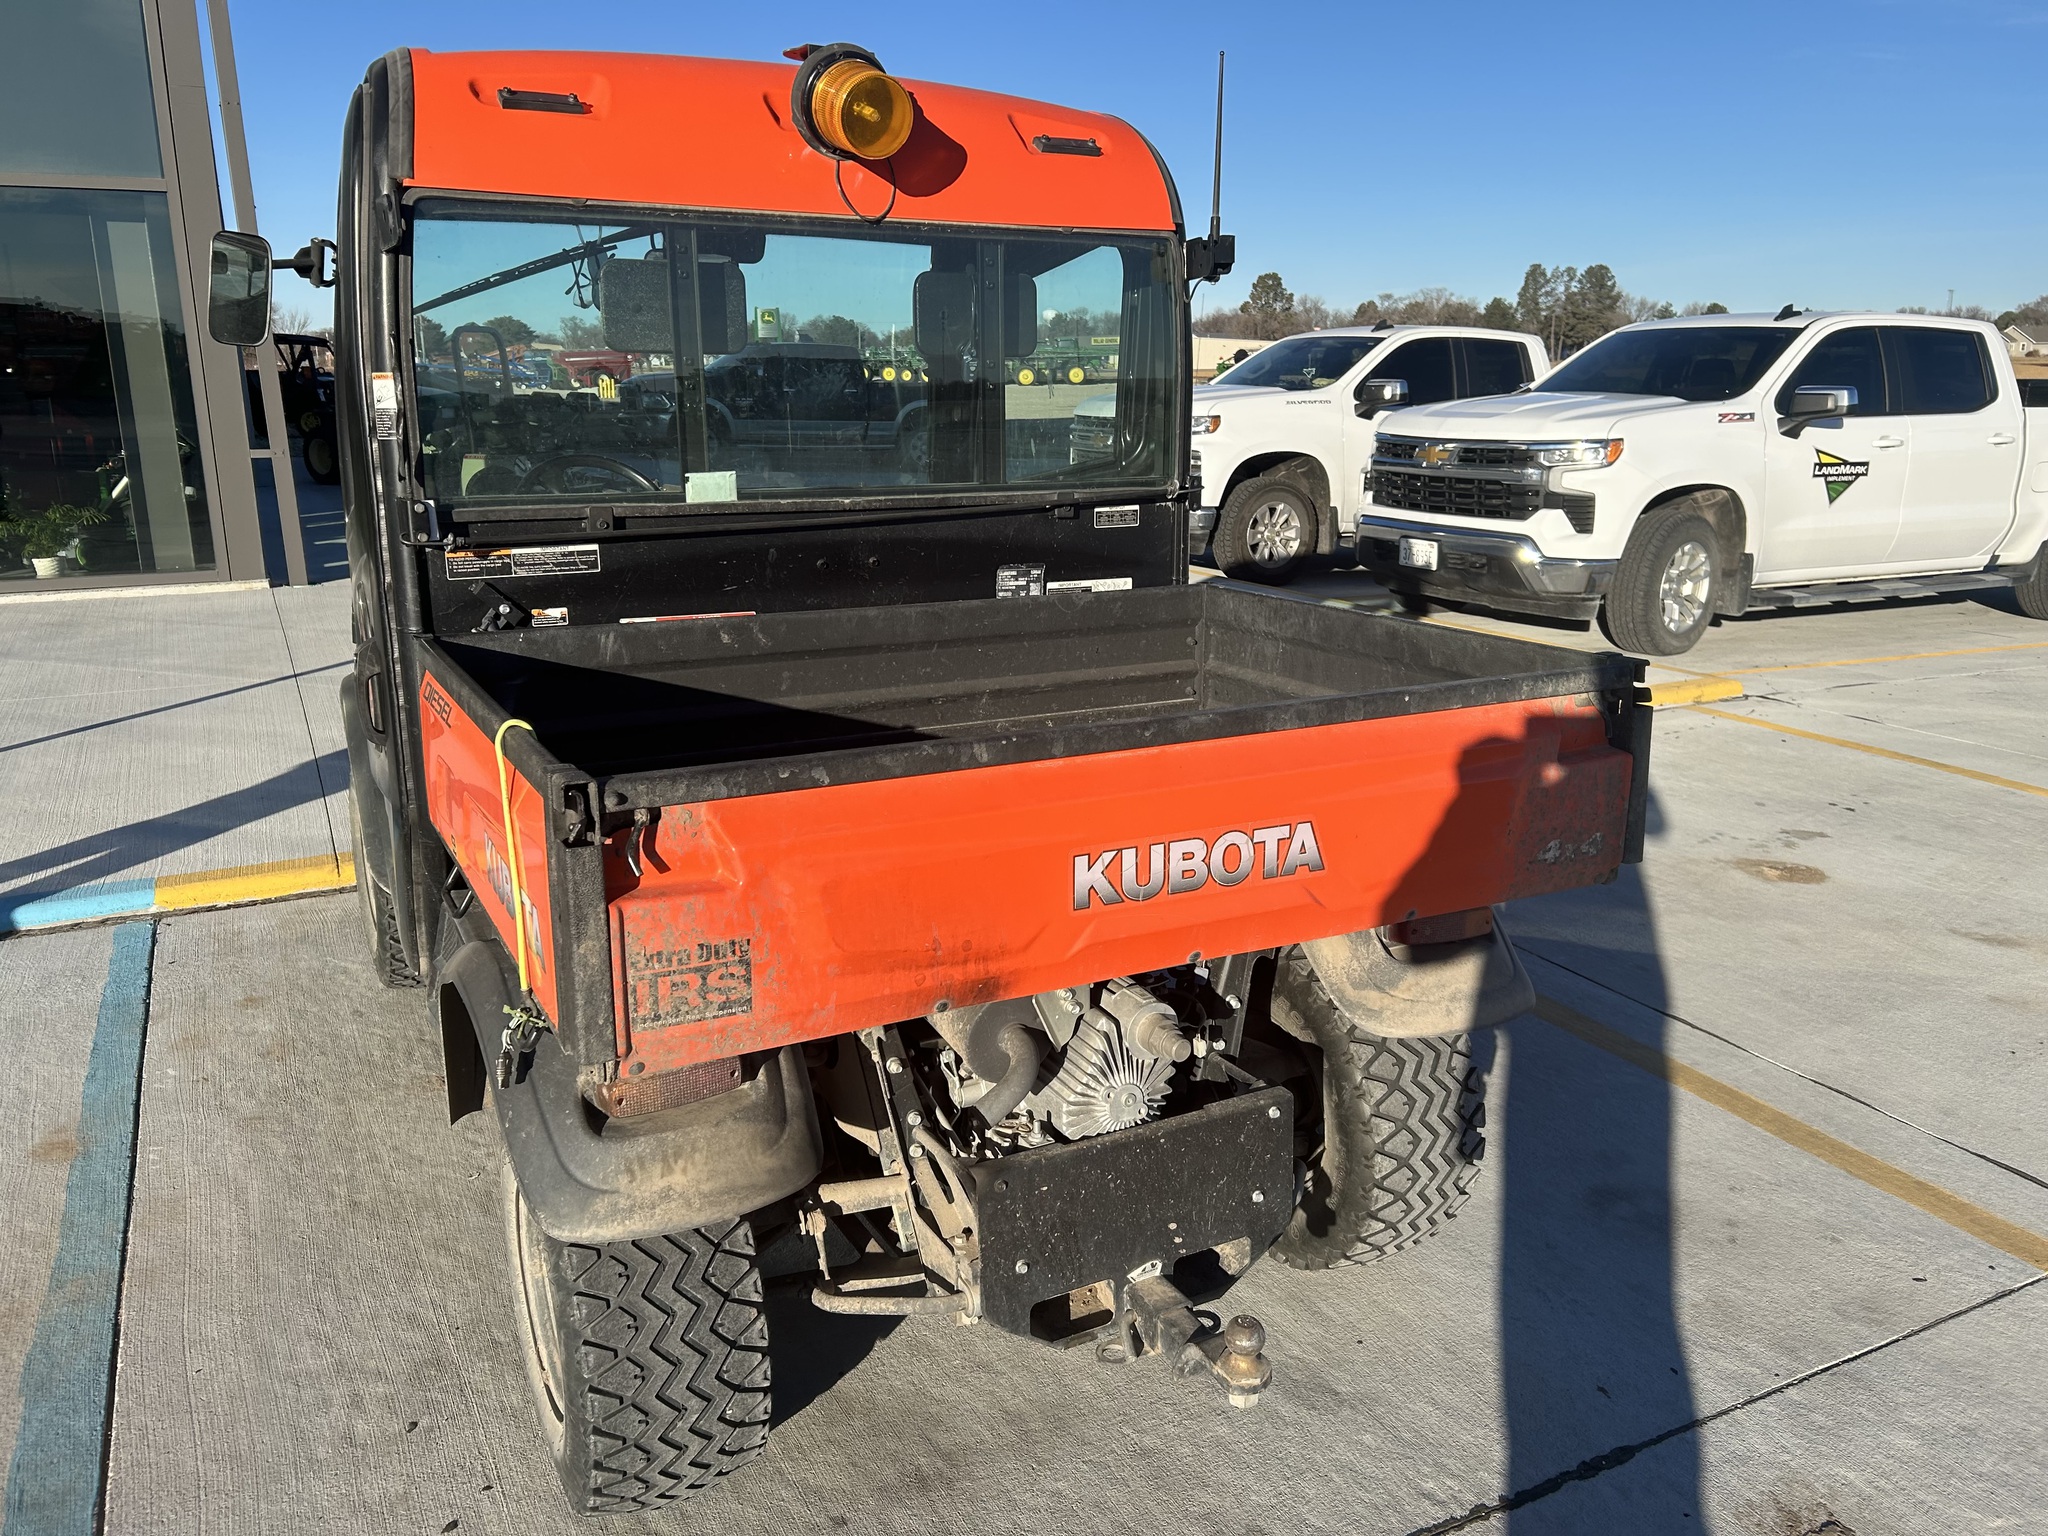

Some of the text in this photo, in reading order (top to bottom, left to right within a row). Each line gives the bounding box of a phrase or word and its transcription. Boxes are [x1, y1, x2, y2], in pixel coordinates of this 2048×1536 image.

[423, 680, 452, 728] DIESEL
[484, 829, 547, 974] KUBTA
[1073, 821, 1325, 911] KUBOTA
